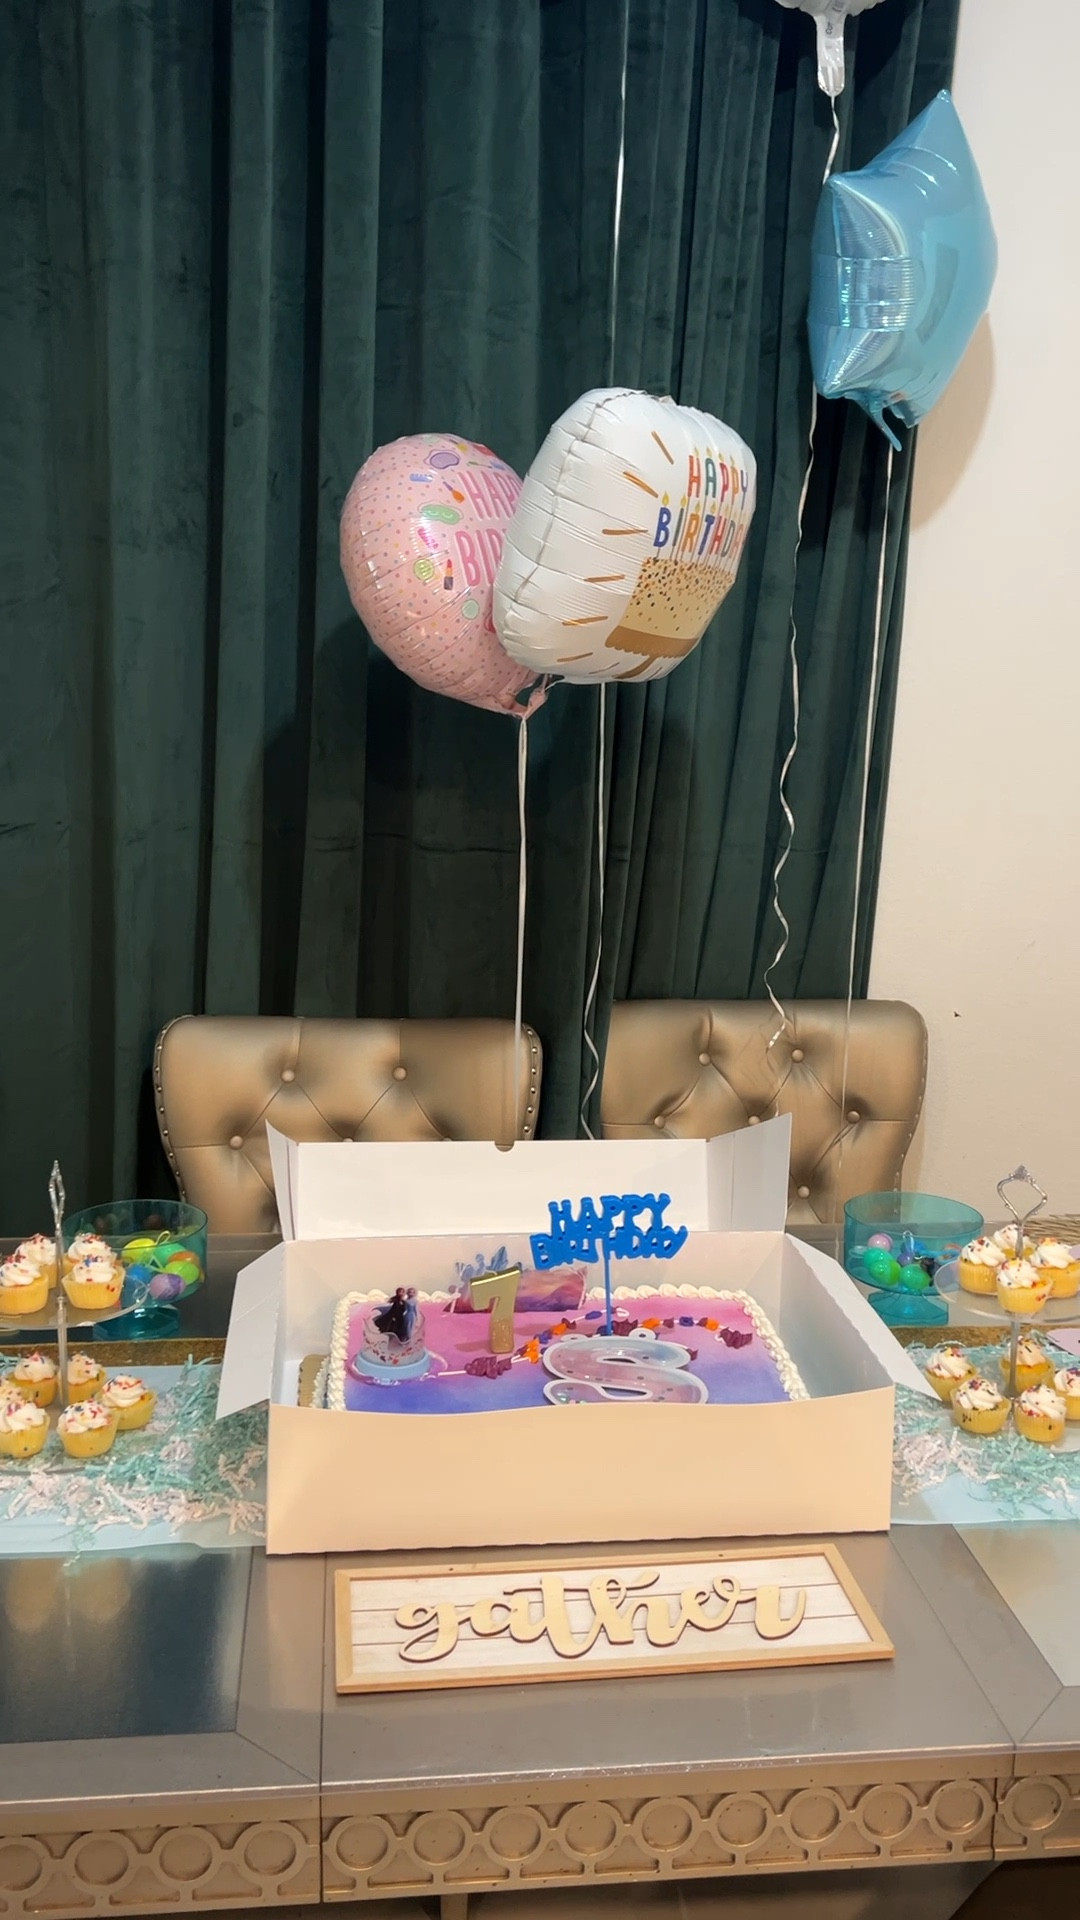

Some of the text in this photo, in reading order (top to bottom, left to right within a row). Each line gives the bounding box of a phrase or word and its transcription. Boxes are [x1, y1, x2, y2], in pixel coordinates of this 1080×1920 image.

[457, 471, 523, 520] HAP
[687, 455, 748, 510] HAPPY
[653, 506, 745, 558] BIRTHDA
[548, 1193, 671, 1239] HAPPY
[530, 1225, 688, 1270] BIRTHDAY
[470, 1267, 522, 1354] 7
[395, 1571, 806, 1662] gather
